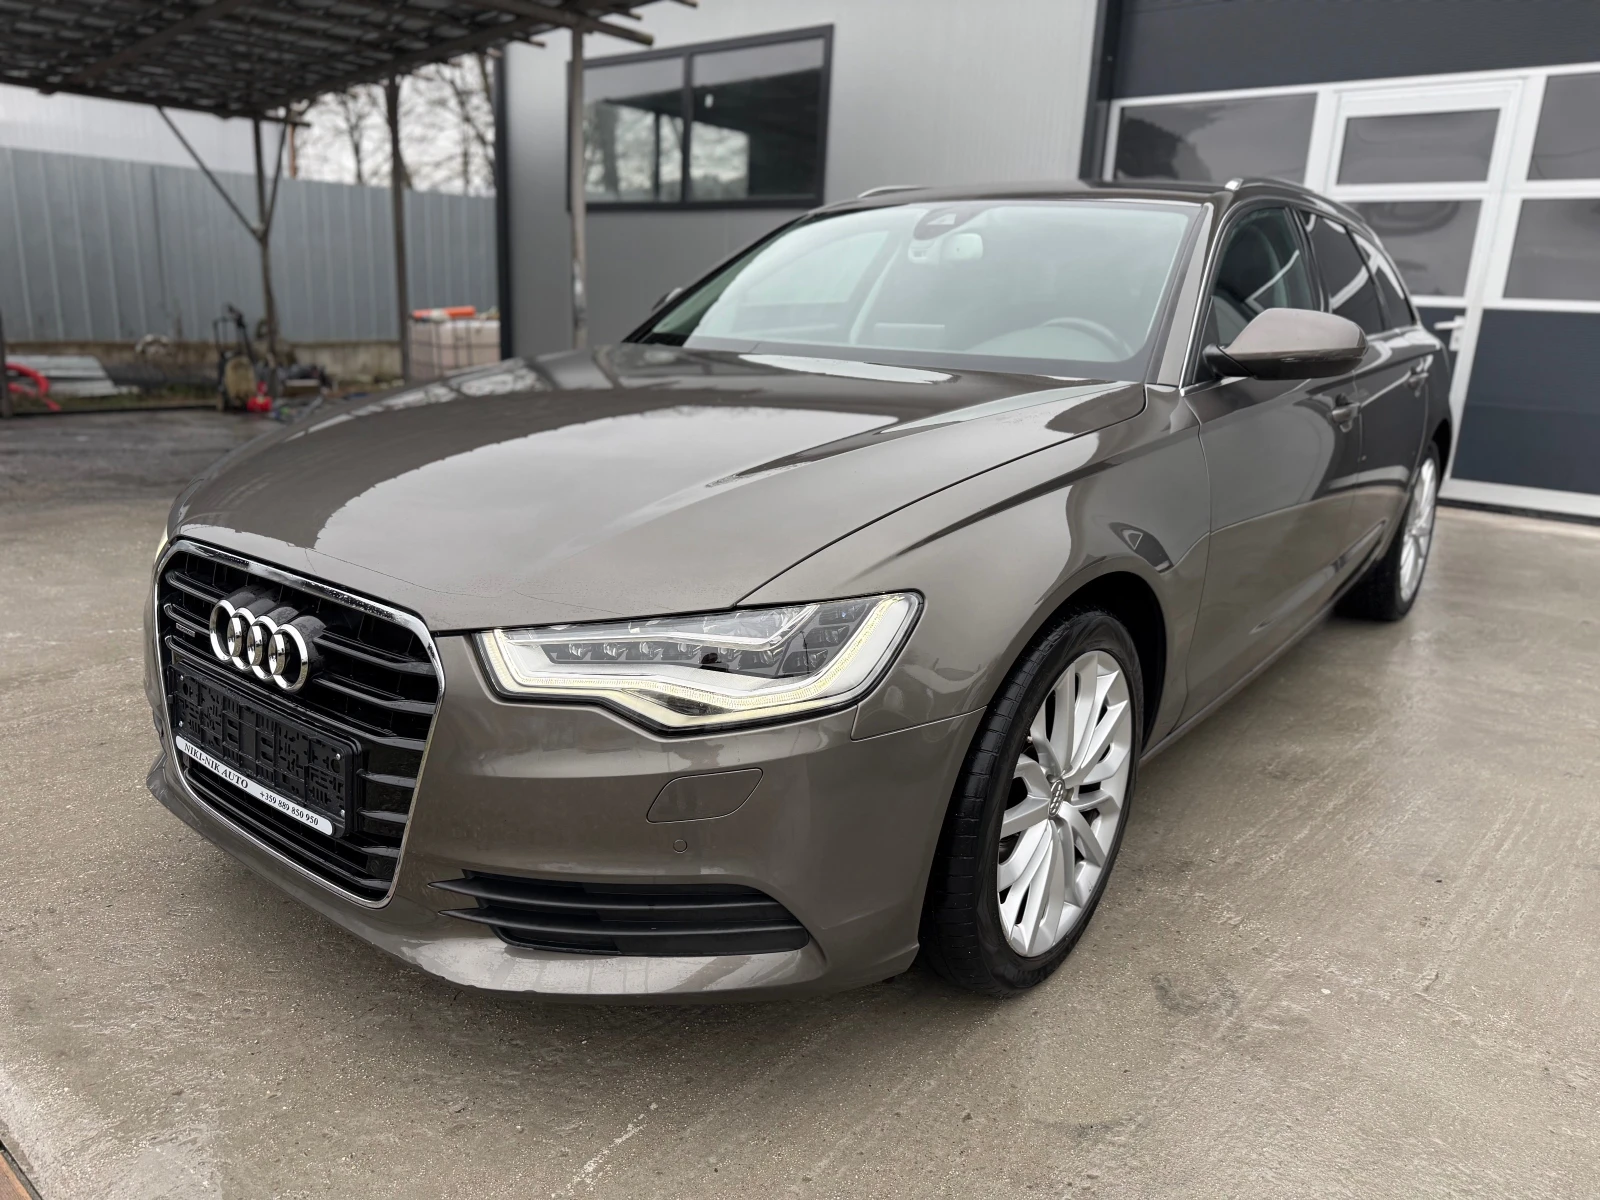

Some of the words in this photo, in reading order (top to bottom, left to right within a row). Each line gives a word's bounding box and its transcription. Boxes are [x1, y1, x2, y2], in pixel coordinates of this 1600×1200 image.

[184, 742, 220, 772] NIKI-NIK
[221, 769, 249, 789] AUTO
[259, 790, 277, 805] +359
[277, 799, 290, 811] 889
[291, 806, 304, 819] 850
[305, 813, 319, 826] 950
